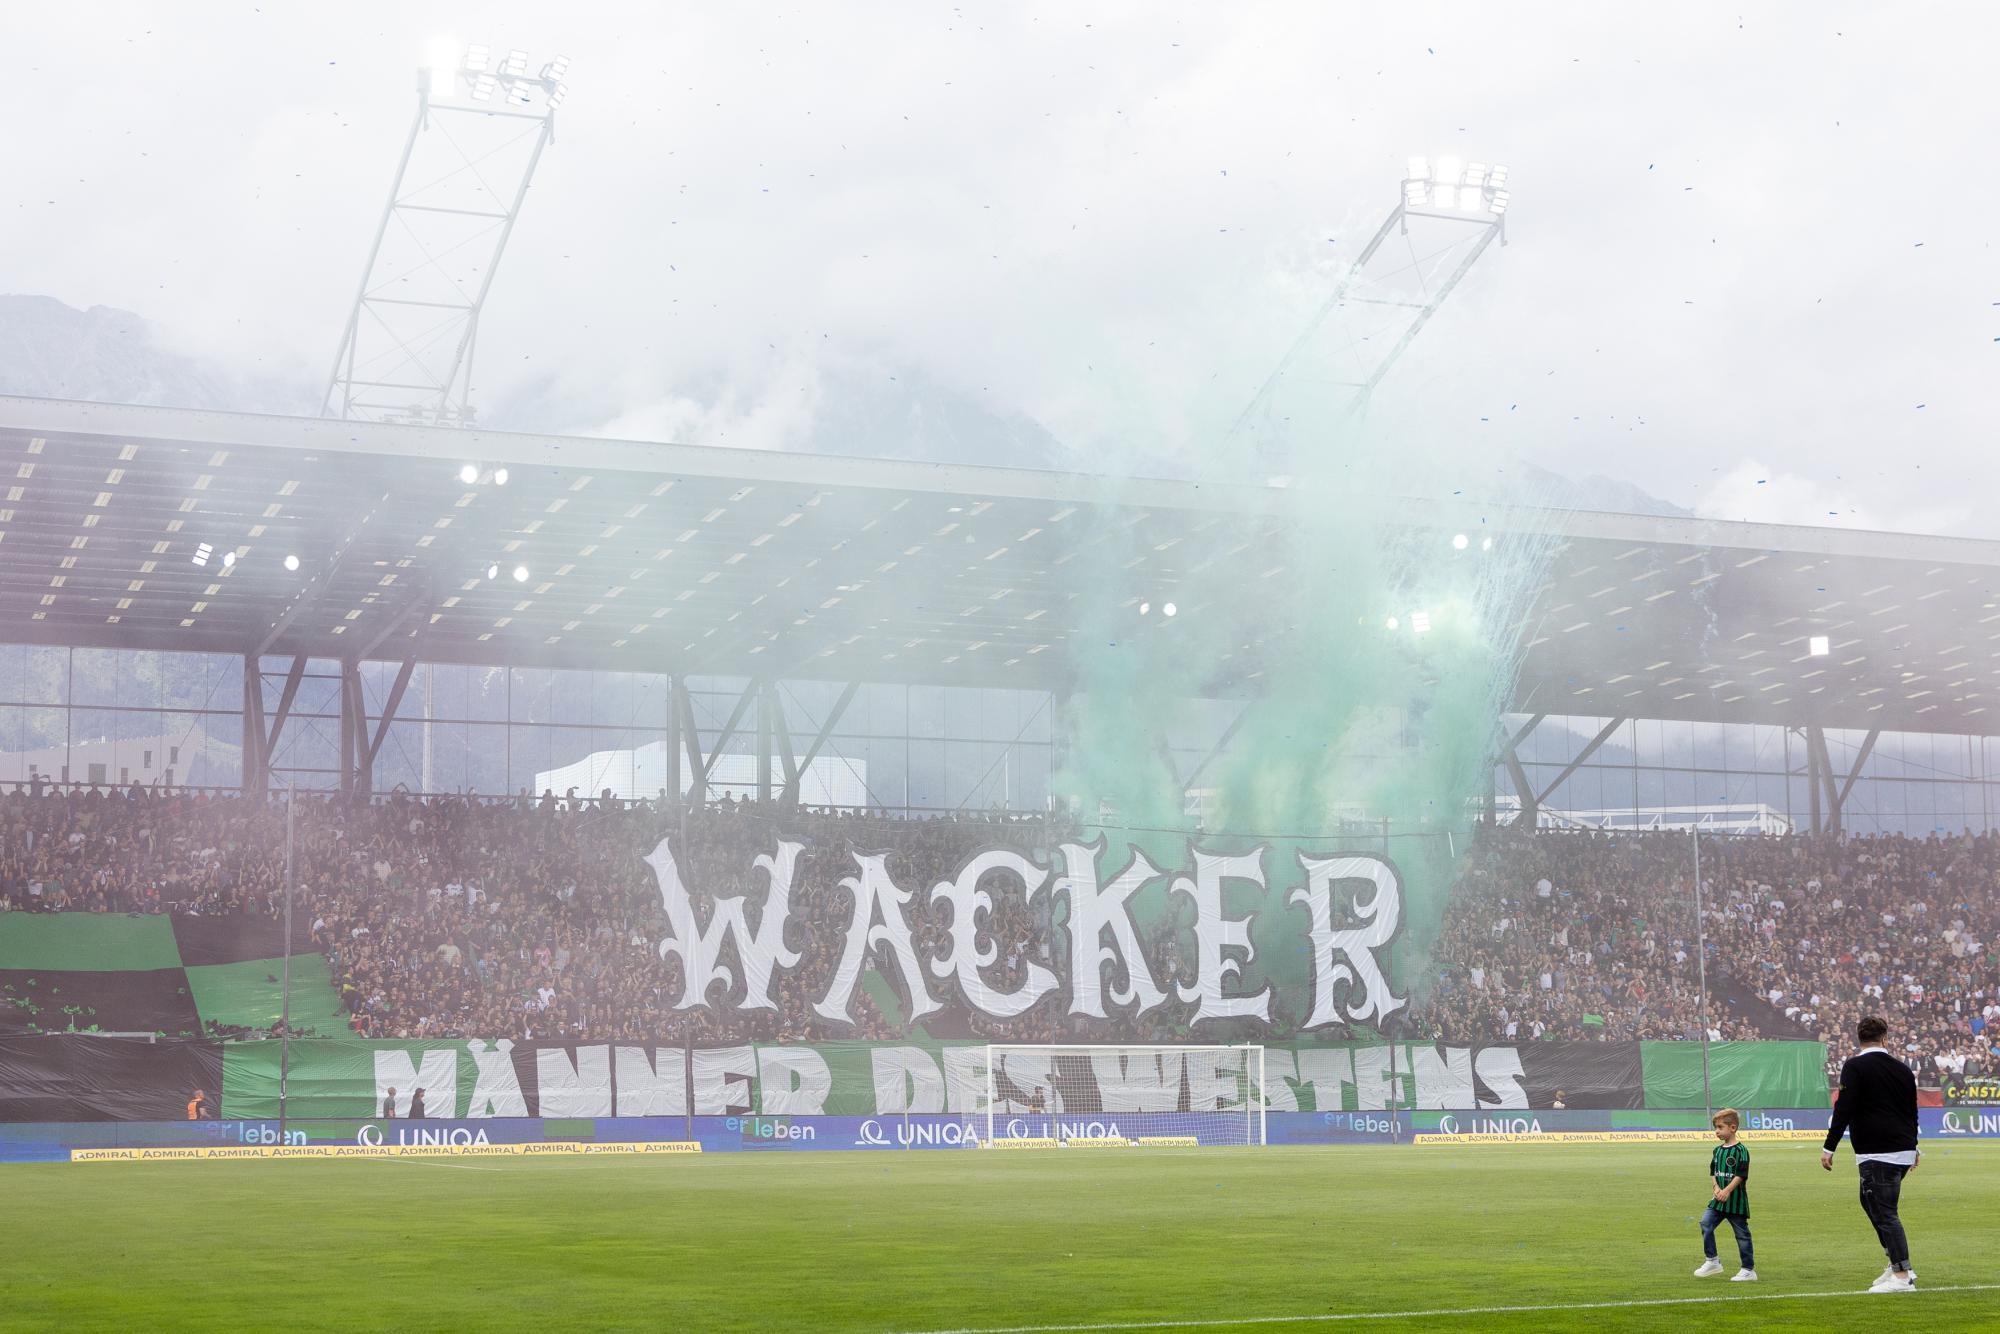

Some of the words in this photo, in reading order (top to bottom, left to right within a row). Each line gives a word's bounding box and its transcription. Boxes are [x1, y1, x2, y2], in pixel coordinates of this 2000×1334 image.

[642, 836, 1407, 1028] WACKER
[374, 1039, 831, 1118] MÄNNER
[871, 1046, 1065, 1114] DES
[1090, 1045, 1529, 1112] WESTENS
[725, 1117, 748, 1133] er
[755, 1117, 815, 1140] leben
[1043, 1121, 1120, 1138] UNIQA
[1349, 1113, 1401, 1134] leben
[1472, 1118, 1542, 1134] UNIQA
[1746, 1110, 1793, 1130] leben
[240, 1121, 307, 1146] leben
[400, 1128, 490, 1145] UNIQA
[897, 1122, 979, 1145] UNIQA
[142, 1150, 203, 1159] ADMIRAL
[207, 1148, 268, 1158] ADMIRAL
[272, 1148, 332, 1157] ADMIRAL
[335, 1147, 396, 1156] ADMIRAL
[400, 1147, 458, 1155] ADMIRAL
[462, 1146, 519, 1155] ADMIRAL
[523, 1143, 581, 1154] ADMIRAL
[644, 1143, 700, 1152] ADMIRAL
